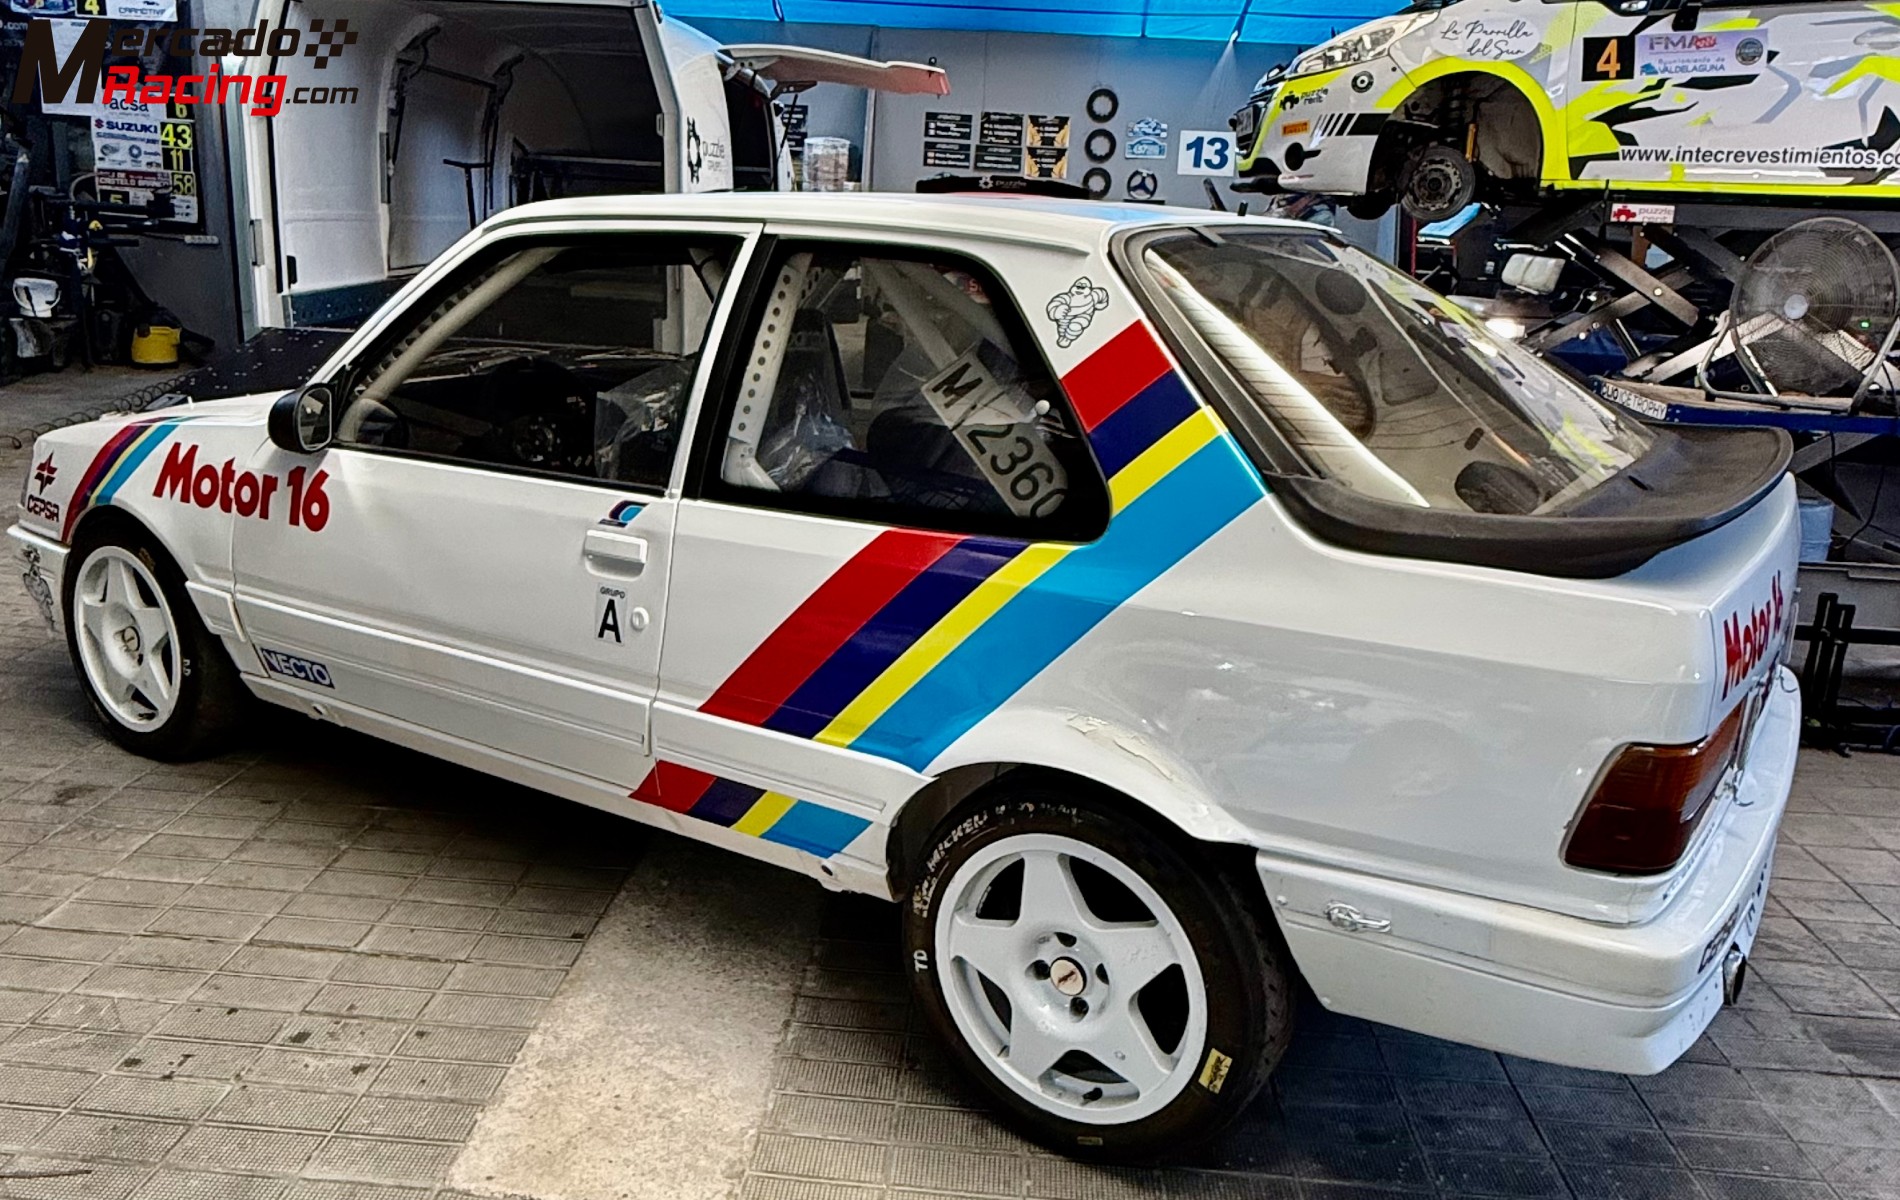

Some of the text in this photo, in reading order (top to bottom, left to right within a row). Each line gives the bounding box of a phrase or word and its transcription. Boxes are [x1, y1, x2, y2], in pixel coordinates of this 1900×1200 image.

[84, 0, 100, 15] 4
[1440, 20, 1534, 40] La Parrilla
[1466, 38, 1525, 60] del Sur
[1596, 38, 1621, 79] 4
[1658, 63, 1726, 75] VALDELAGUNA
[106, 121, 158, 134] SUZUKI
[161, 123, 193, 149] 43
[170, 149, 184, 172] 11
[1186, 136, 1229, 170] 13
[173, 173, 194, 195] 58
[1639, 207, 1674, 216] puzzle
[931, 362, 983, 409] M
[1632, 394, 1667, 419] TROPHY
[152, 441, 330, 532] Motor 16
[27, 494, 60, 523] CEPSA
[600, 586, 626, 599] GRUPO
[597, 598, 622, 644] A
[1721, 598, 1772, 702] Motor
[913, 949, 929, 973] TD
